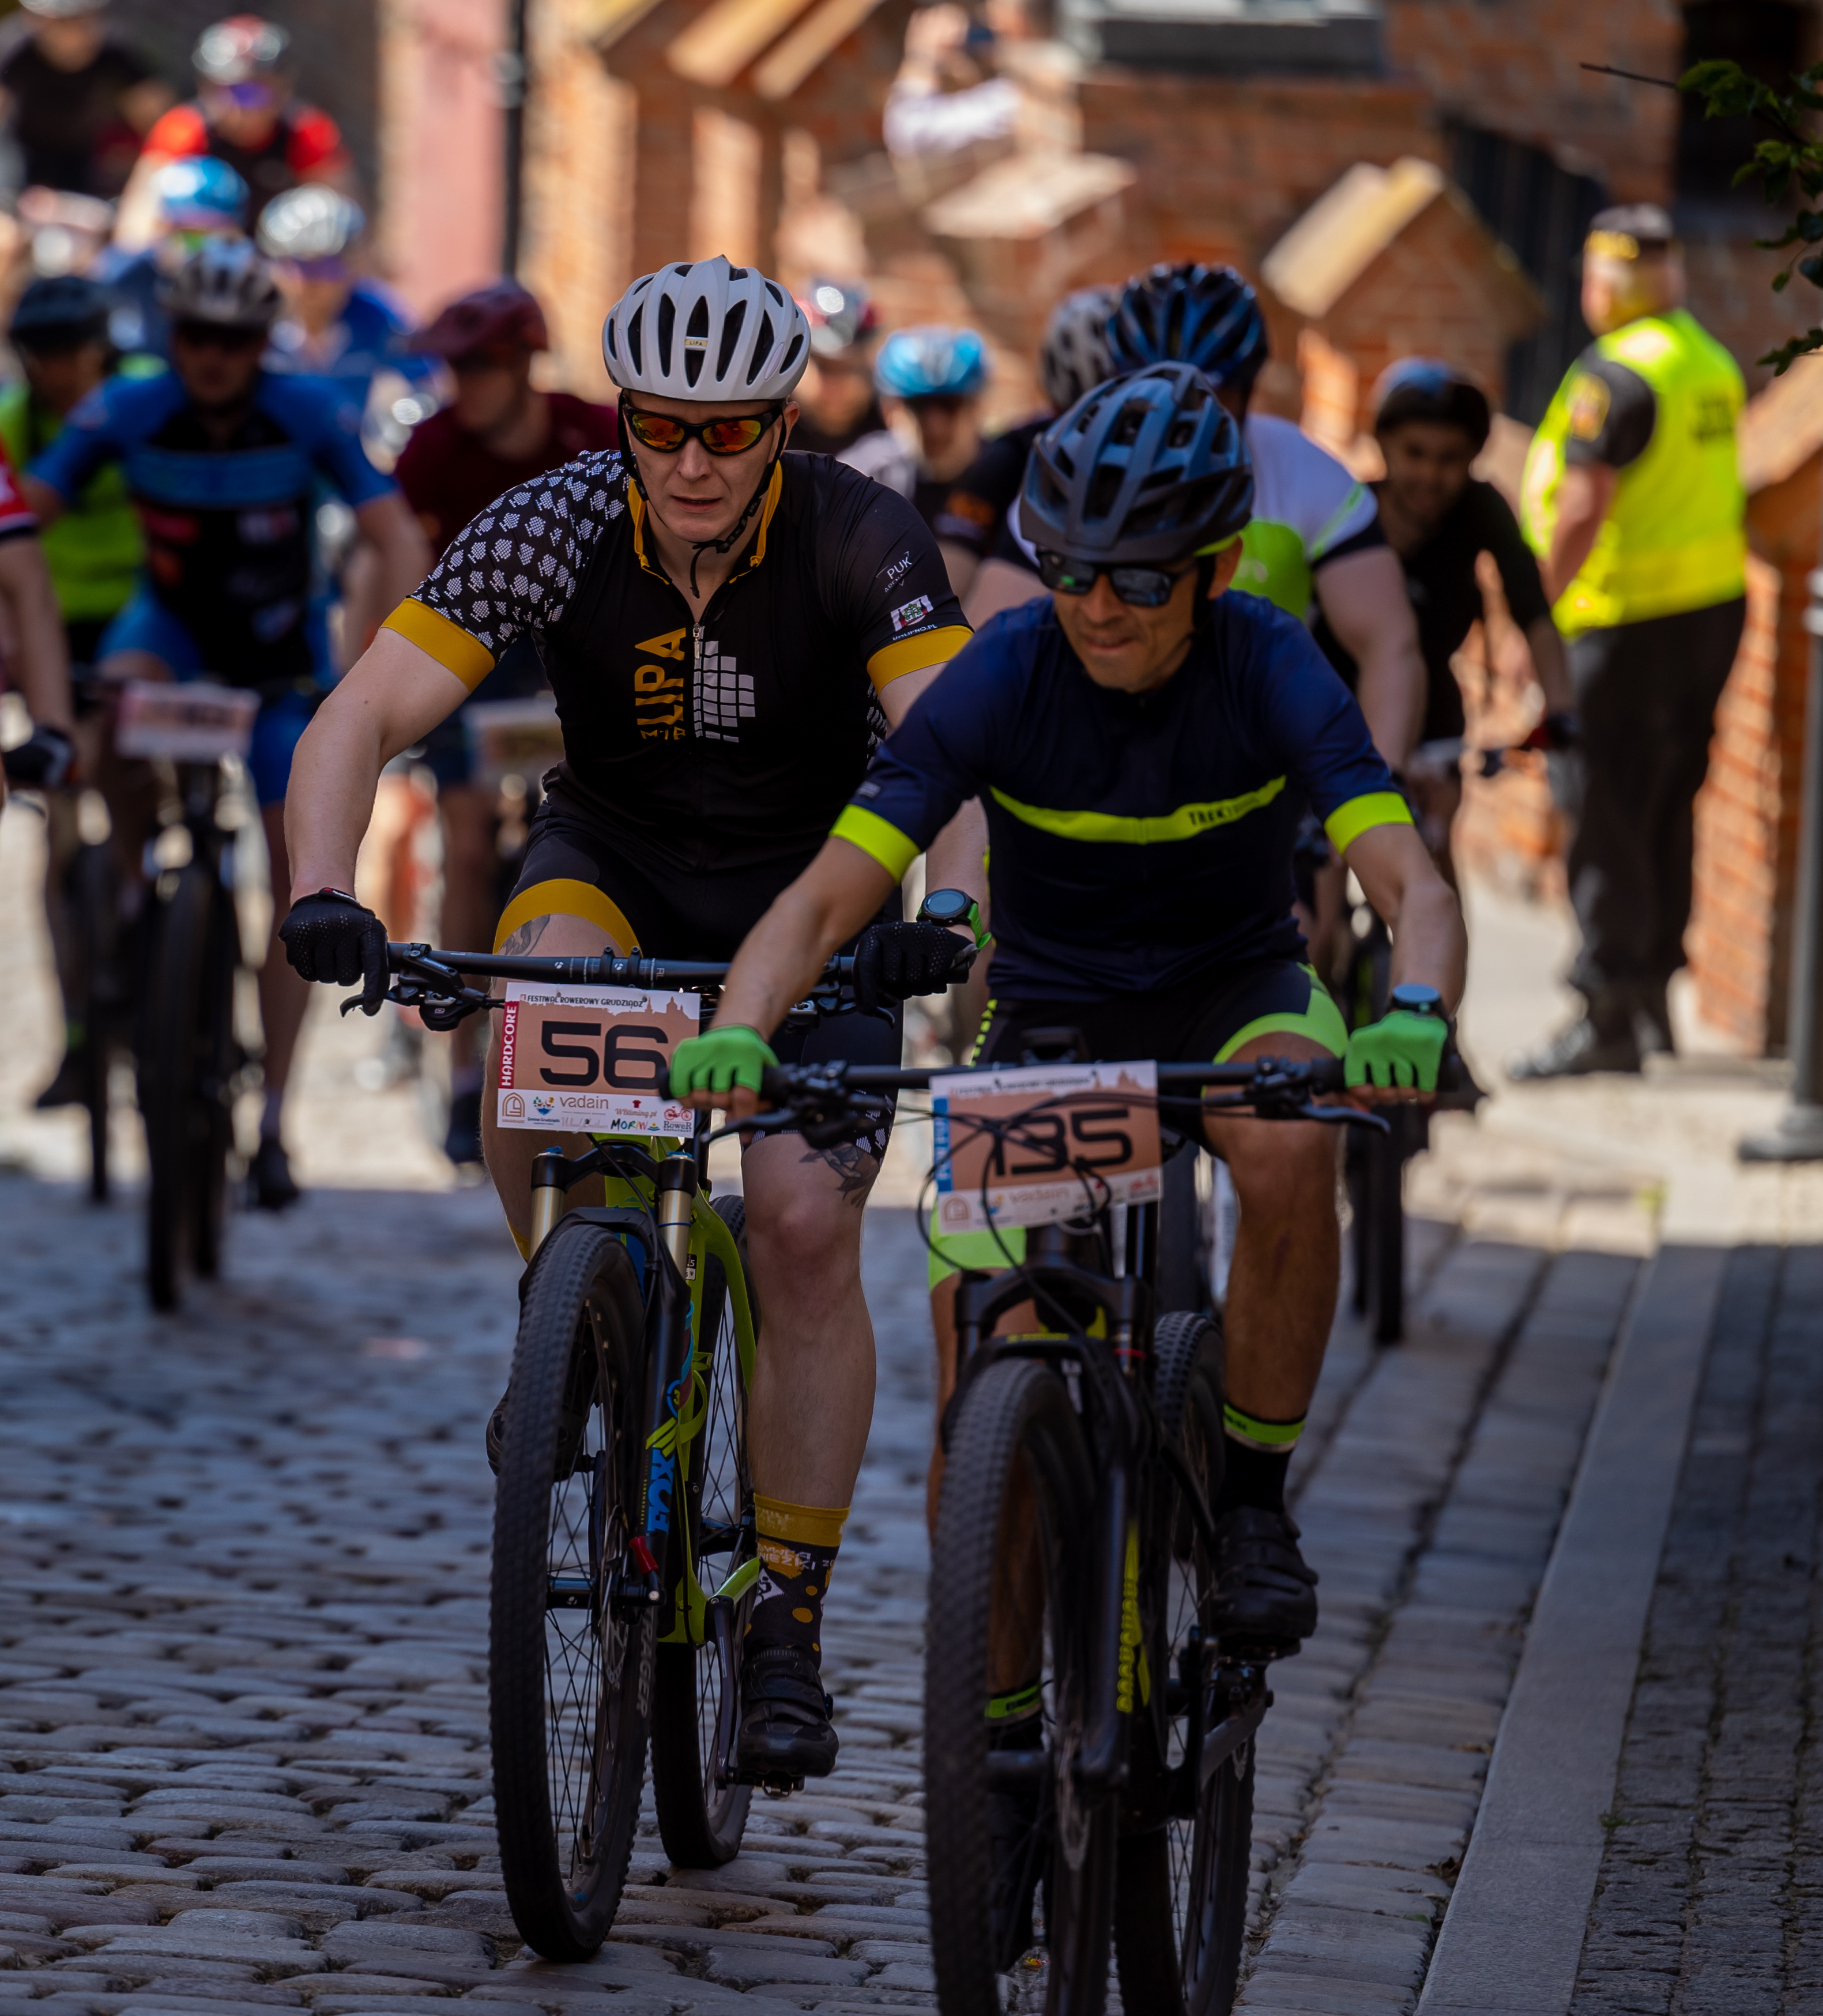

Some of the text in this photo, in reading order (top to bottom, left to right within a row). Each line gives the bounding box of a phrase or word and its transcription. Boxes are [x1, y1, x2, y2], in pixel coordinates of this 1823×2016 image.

[887, 556, 912, 579] PUK
[635, 627, 686, 725] LIPA
[527, 995, 643, 1008] FESTIWAL ROWEROWY GRUDZIĄDZ
[501, 1005, 517, 1086] HARDCORE
[539, 1020, 669, 1090] 56
[559, 1095, 609, 1110] vadain
[647, 1449, 675, 1535] FOX
